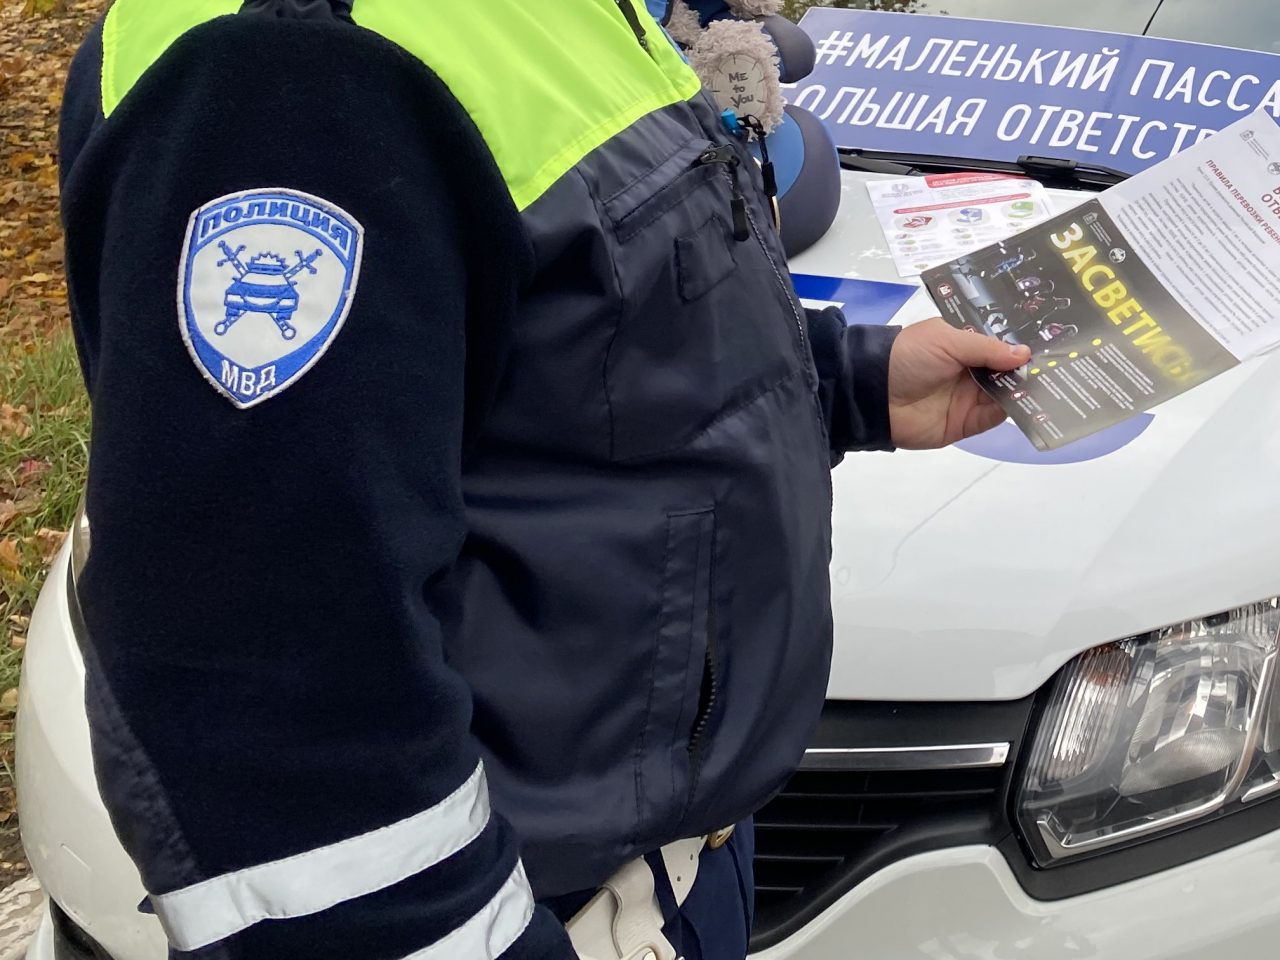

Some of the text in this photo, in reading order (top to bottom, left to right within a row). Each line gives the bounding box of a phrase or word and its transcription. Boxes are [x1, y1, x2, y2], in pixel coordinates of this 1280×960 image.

[815, 30, 1120, 92] #МАЛЕНЬКИЙ
[733, 85, 745, 93] to
[1206, 159, 1233, 190] ПРАВИЛА
[1230, 188, 1265, 224] ПЕРЕВОЗКИ
[200, 200, 350, 252] ПОЛИЦИЯ
[221, 359, 276, 395] МВД
